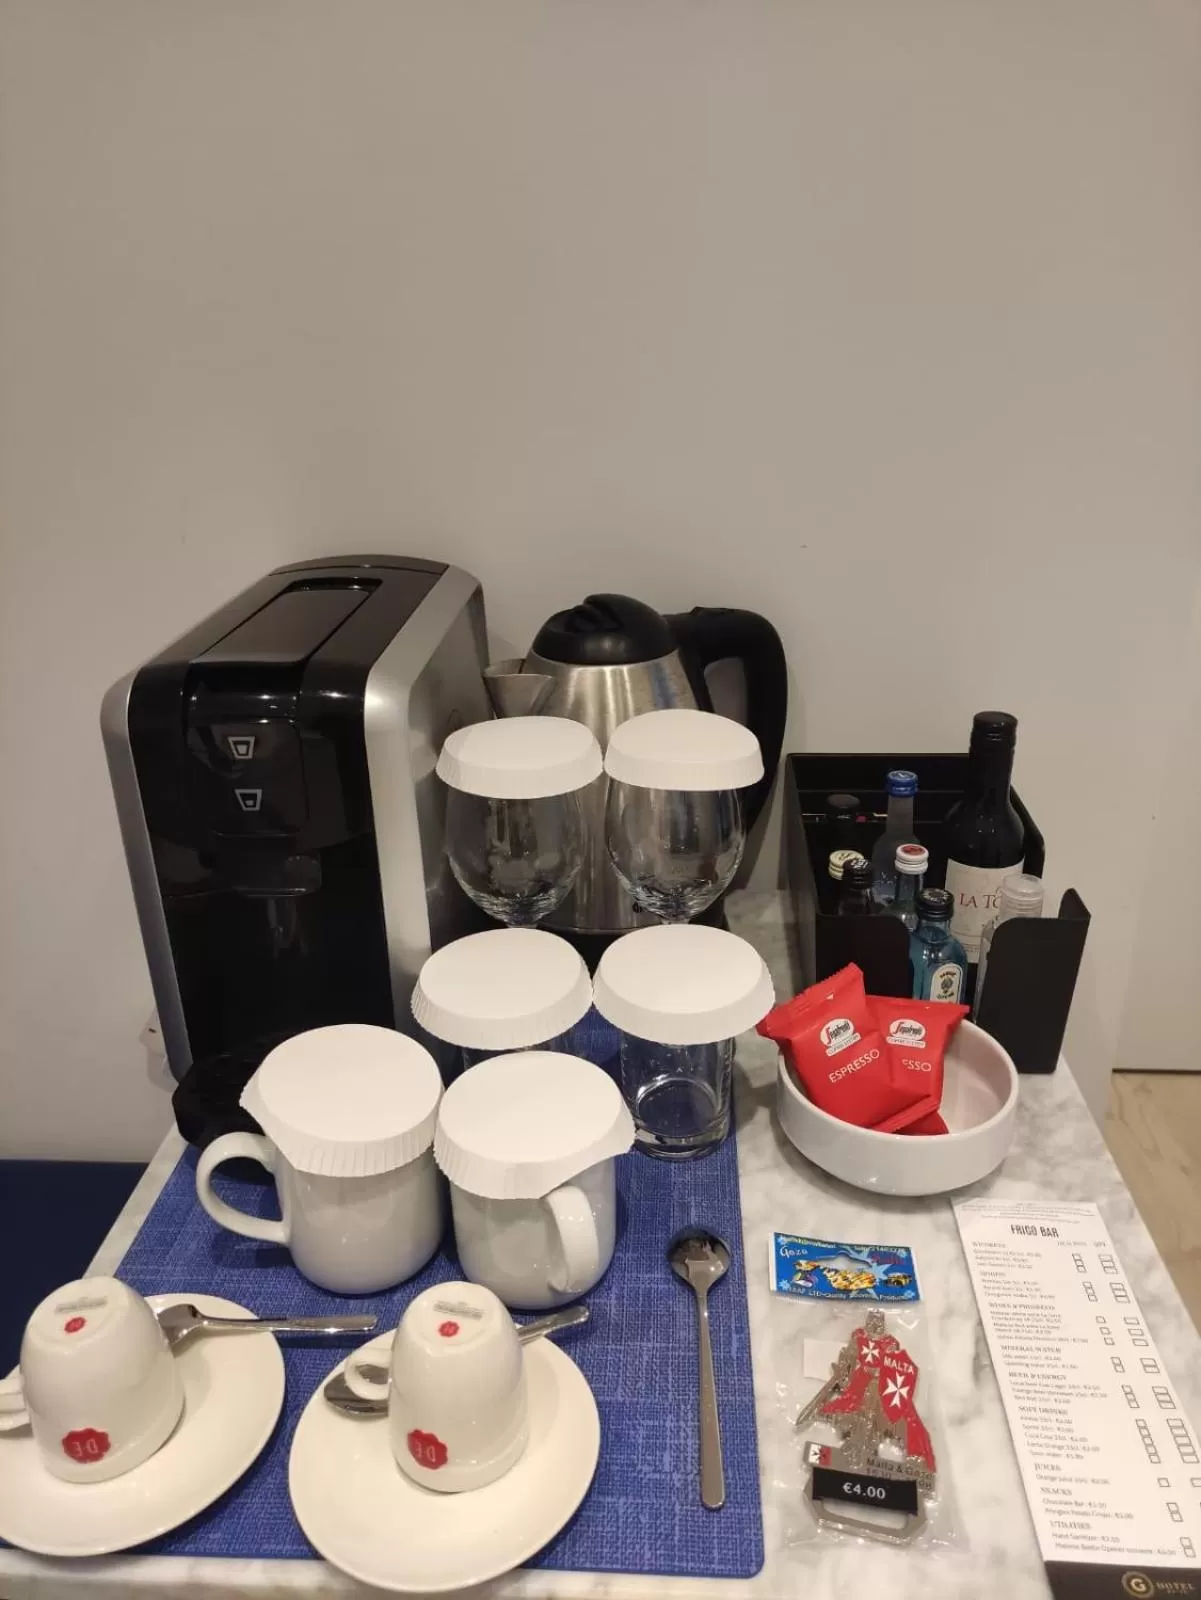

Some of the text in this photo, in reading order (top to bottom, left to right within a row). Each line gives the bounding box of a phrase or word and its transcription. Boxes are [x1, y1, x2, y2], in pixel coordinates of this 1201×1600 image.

[960, 893, 977, 908] LA
[828, 1048, 880, 1083] ESPRESSO
[1010, 1223, 1059, 1238] FRIGO BAR
[883, 1357, 915, 1375] MALTA
[867, 1457, 893, 1471] Malta
[895, 1464, 903, 1473] &
[843, 1482, 886, 1499] €4.00
[1131, 1578, 1146, 1592] G
